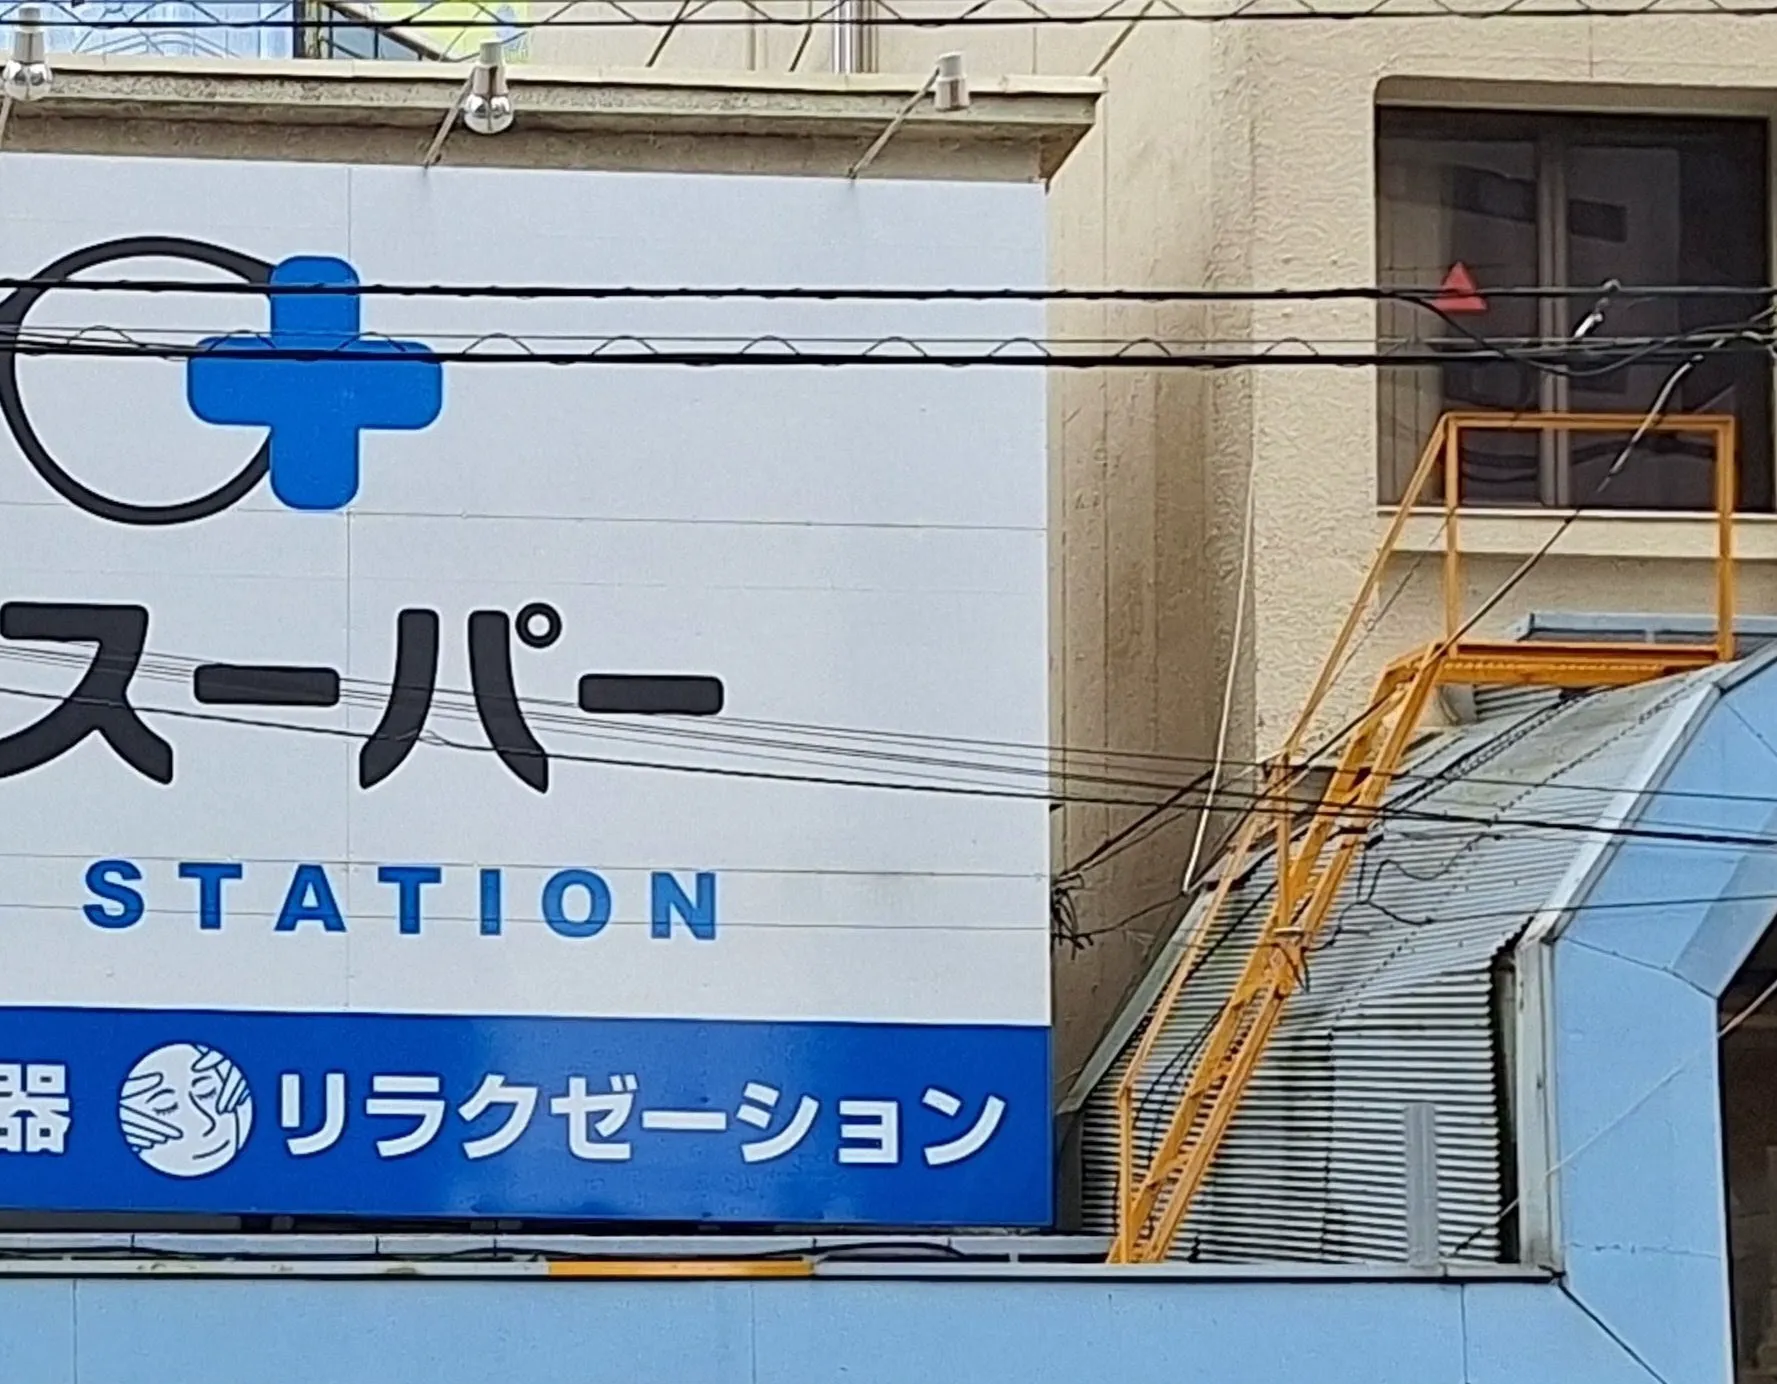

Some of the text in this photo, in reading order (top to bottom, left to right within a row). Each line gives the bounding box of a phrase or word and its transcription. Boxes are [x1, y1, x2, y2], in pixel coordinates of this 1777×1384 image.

[84, 858, 717, 940] STATION
[280, 1071, 1005, 1167] リラクゼーション
